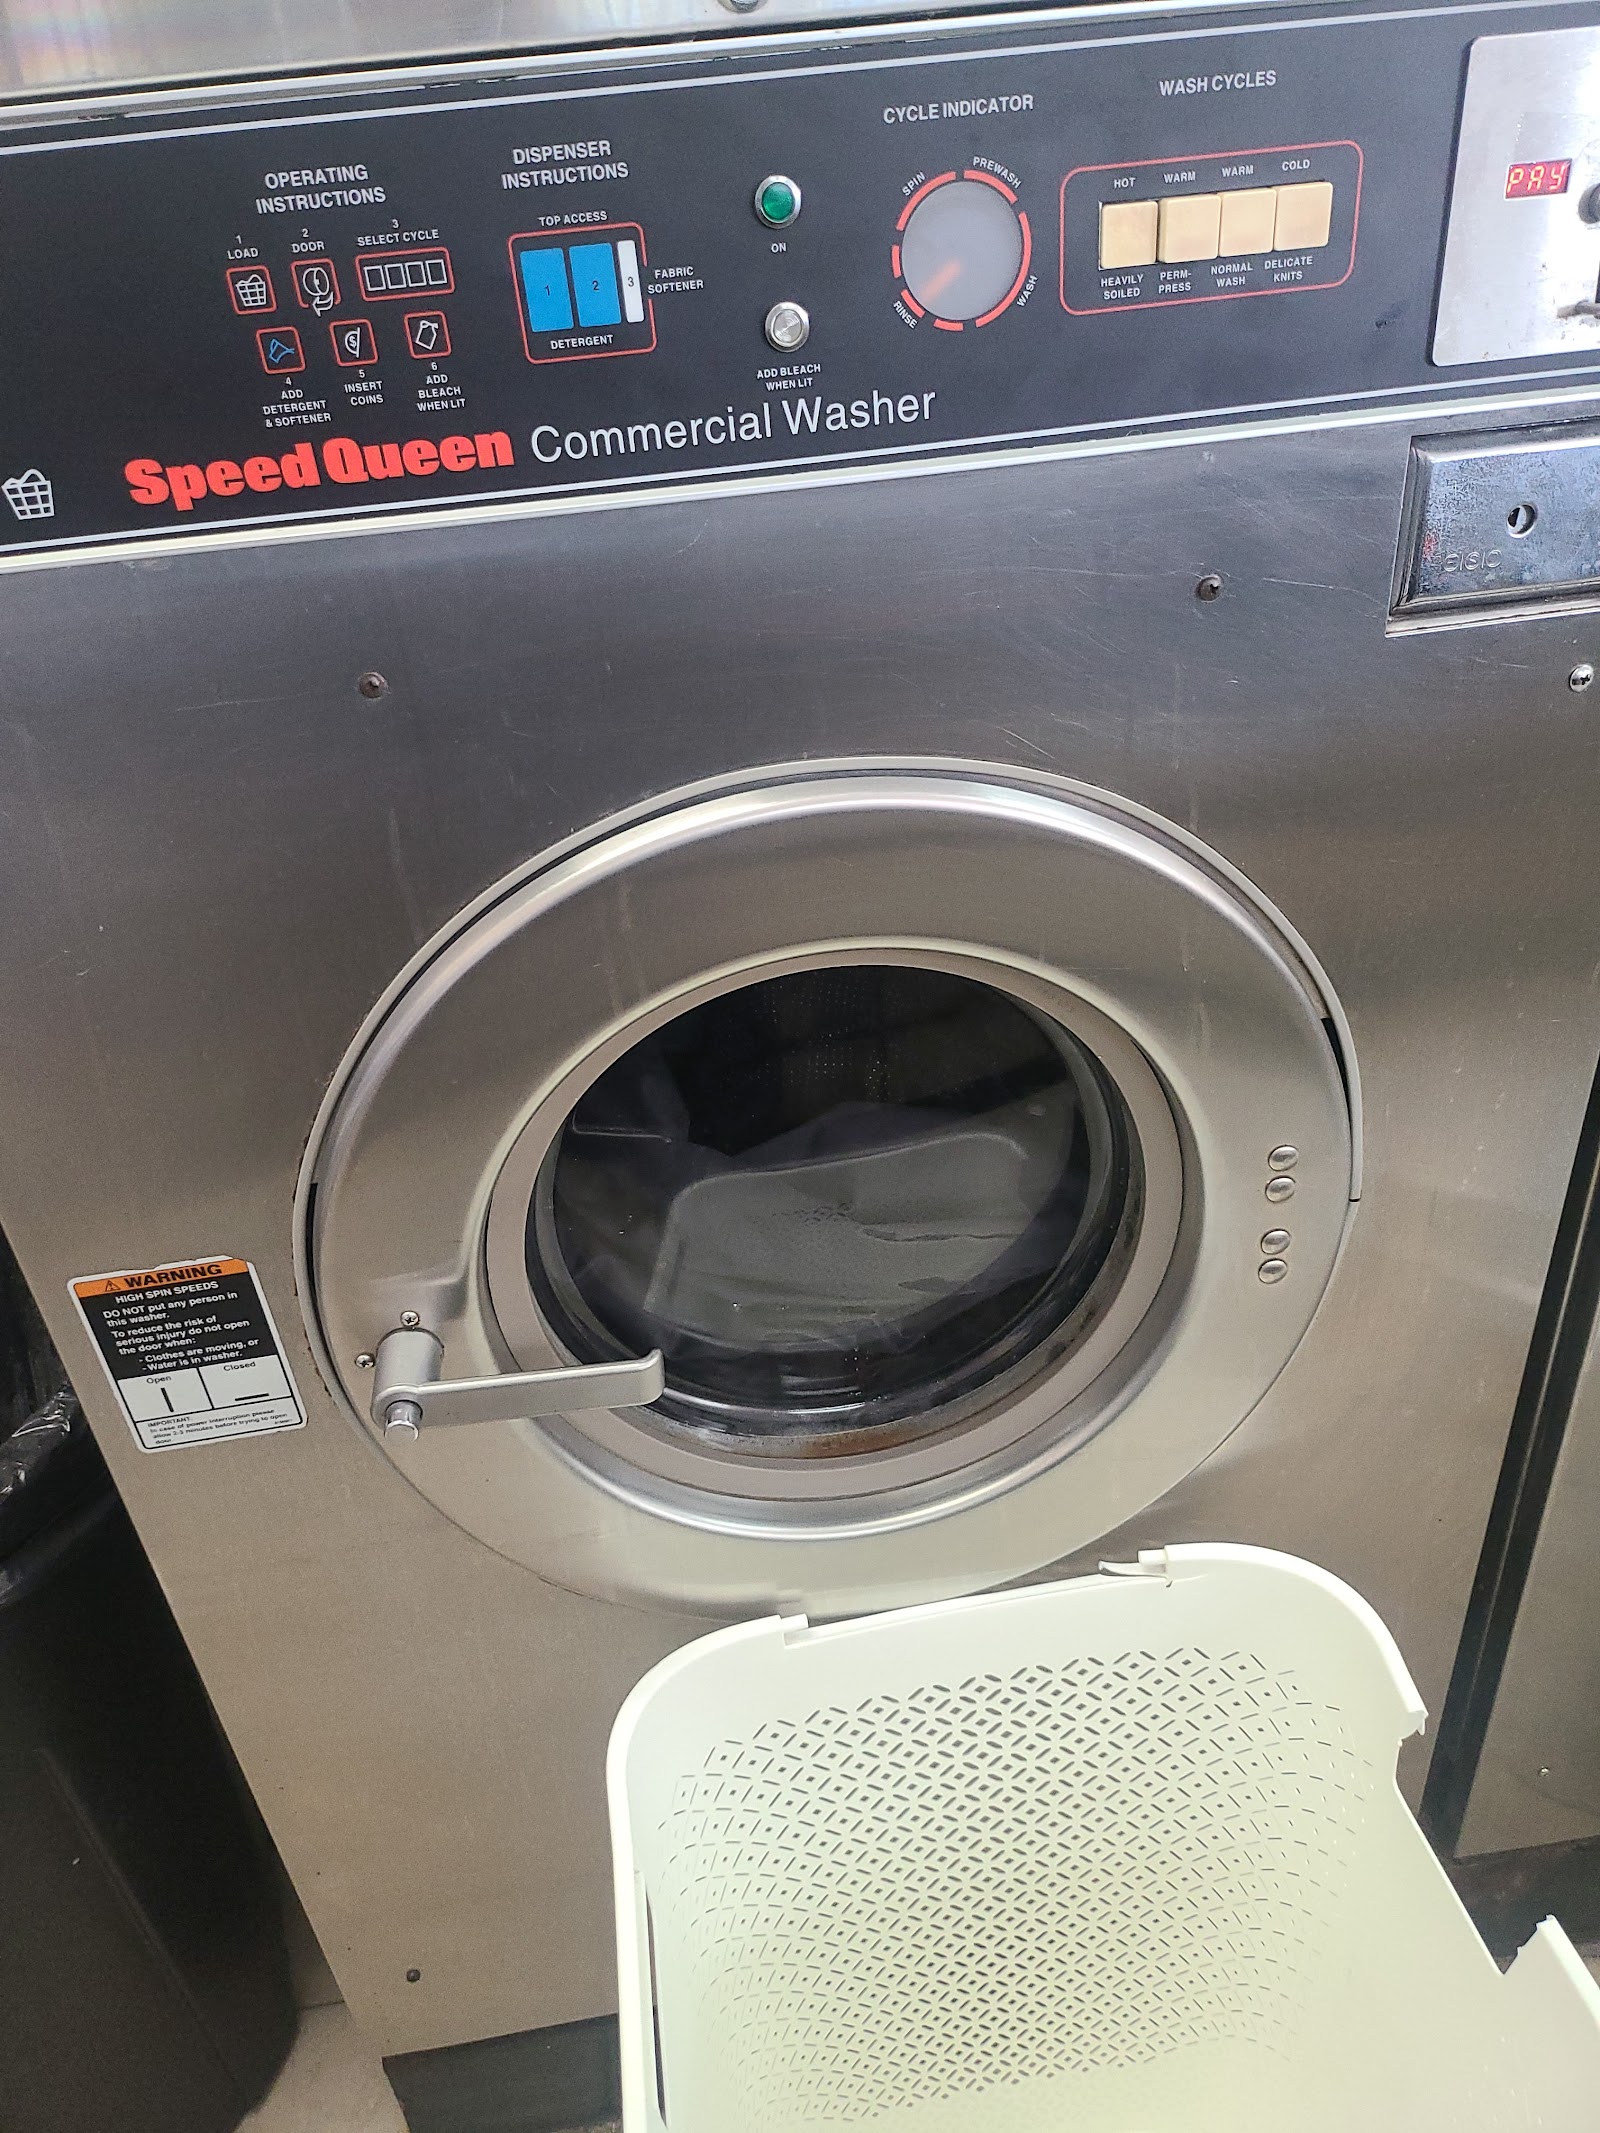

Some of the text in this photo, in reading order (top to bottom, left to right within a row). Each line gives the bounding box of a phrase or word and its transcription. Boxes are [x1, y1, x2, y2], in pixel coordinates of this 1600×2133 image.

[1160, 70, 1276, 96] WASH CYCLES
[884, 94, 1034, 124] CYCLE INDICATOR
[513, 140, 611, 164] DISPENSER
[1222, 165, 1254, 177] WARM
[1282, 159, 1310, 171] COLD
[265, 164, 368, 189] OPERATING
[502, 162, 629, 189] INSTRUCTIONS
[973, 156, 1022, 189] PREWASH
[1164, 172, 1196, 183] WARM
[1507, 164, 1567, 193] PAY
[902, 172, 926, 196] SPIN
[1114, 178, 1136, 188] HOT
[256, 186, 386, 214] INSTRUCTIONS
[392, 219, 399, 228] 3
[539, 211, 607, 226] TOP ACCESS
[302, 228, 309, 237] 2
[357, 229, 439, 246] SELECT CYCLE
[236, 235, 241, 244] 1
[292, 241, 324, 253] DOOR
[771, 243, 786, 253] ON
[227, 248, 258, 260] LOAD
[1211, 262, 1253, 275] NORMAL
[1264, 256, 1313, 270] DELICATE
[655, 266, 694, 279] FABRIC
[1160, 270, 1192, 281] PERM-
[1273, 271, 1302, 282] KNITS
[592, 280, 599, 290] 2
[628, 277, 634, 287] 3
[648, 280, 704, 294] SOFTENER
[1101, 274, 1144, 287] HEAVILY
[1216, 276, 1246, 288] WASH
[545, 285, 550, 295] 1
[1017, 275, 1038, 307] WASH
[1104, 287, 1140, 300] SOILED
[1158, 282, 1191, 294] PRESS
[893, 300, 917, 328] RINSE
[550, 335, 613, 350] DETERGENT
[431, 362, 438, 371] 6
[756, 364, 821, 379] ADD BLEACH
[359, 370, 365, 378] 5
[426, 374, 448, 384] ADD
[285, 377, 292, 386] 4
[344, 381, 383, 393] INSERT
[766, 378, 813, 391] WHEN LIT
[281, 389, 303, 400] ADD
[418, 386, 461, 399] BLEACH
[350, 394, 384, 406] COINS
[417, 399, 466, 412] WHEN LIT
[263, 400, 326, 415] DETERGENT
[265, 413, 331, 428] & SOFTENER
[531, 390, 936, 463] Commercial Washer
[124, 430, 514, 511] Speed Queen
[124, 1264, 222, 1288] WARNING
[115, 1281, 219, 1304] HIGH SPIN SPEEDS
[103, 1310, 120, 1319] DO
[122, 1305, 145, 1315] NOT
[148, 1303, 166, 1314] put
[168, 1299, 186, 1309] any
[190, 1295, 225, 1306] person
[107, 1312, 170, 1327] this washer.
[127, 1324, 163, 1335] reduce
[165, 1321, 182, 1330] the
[184, 1318, 204, 1327] risk
[206, 1315, 217, 1323] of
[116, 1320, 250, 1346] serious injury do not open
[118, 1338, 196, 1355] the door when:
[145, 1349, 185, 1363] Clothes
[205, 1341, 247, 1353] moving,
[147, 1361, 177, 1371] Water
[203, 1350, 243, 1362] washer.
[223, 1362, 256, 1371] Closed
[147, 1375, 171, 1384] Open
